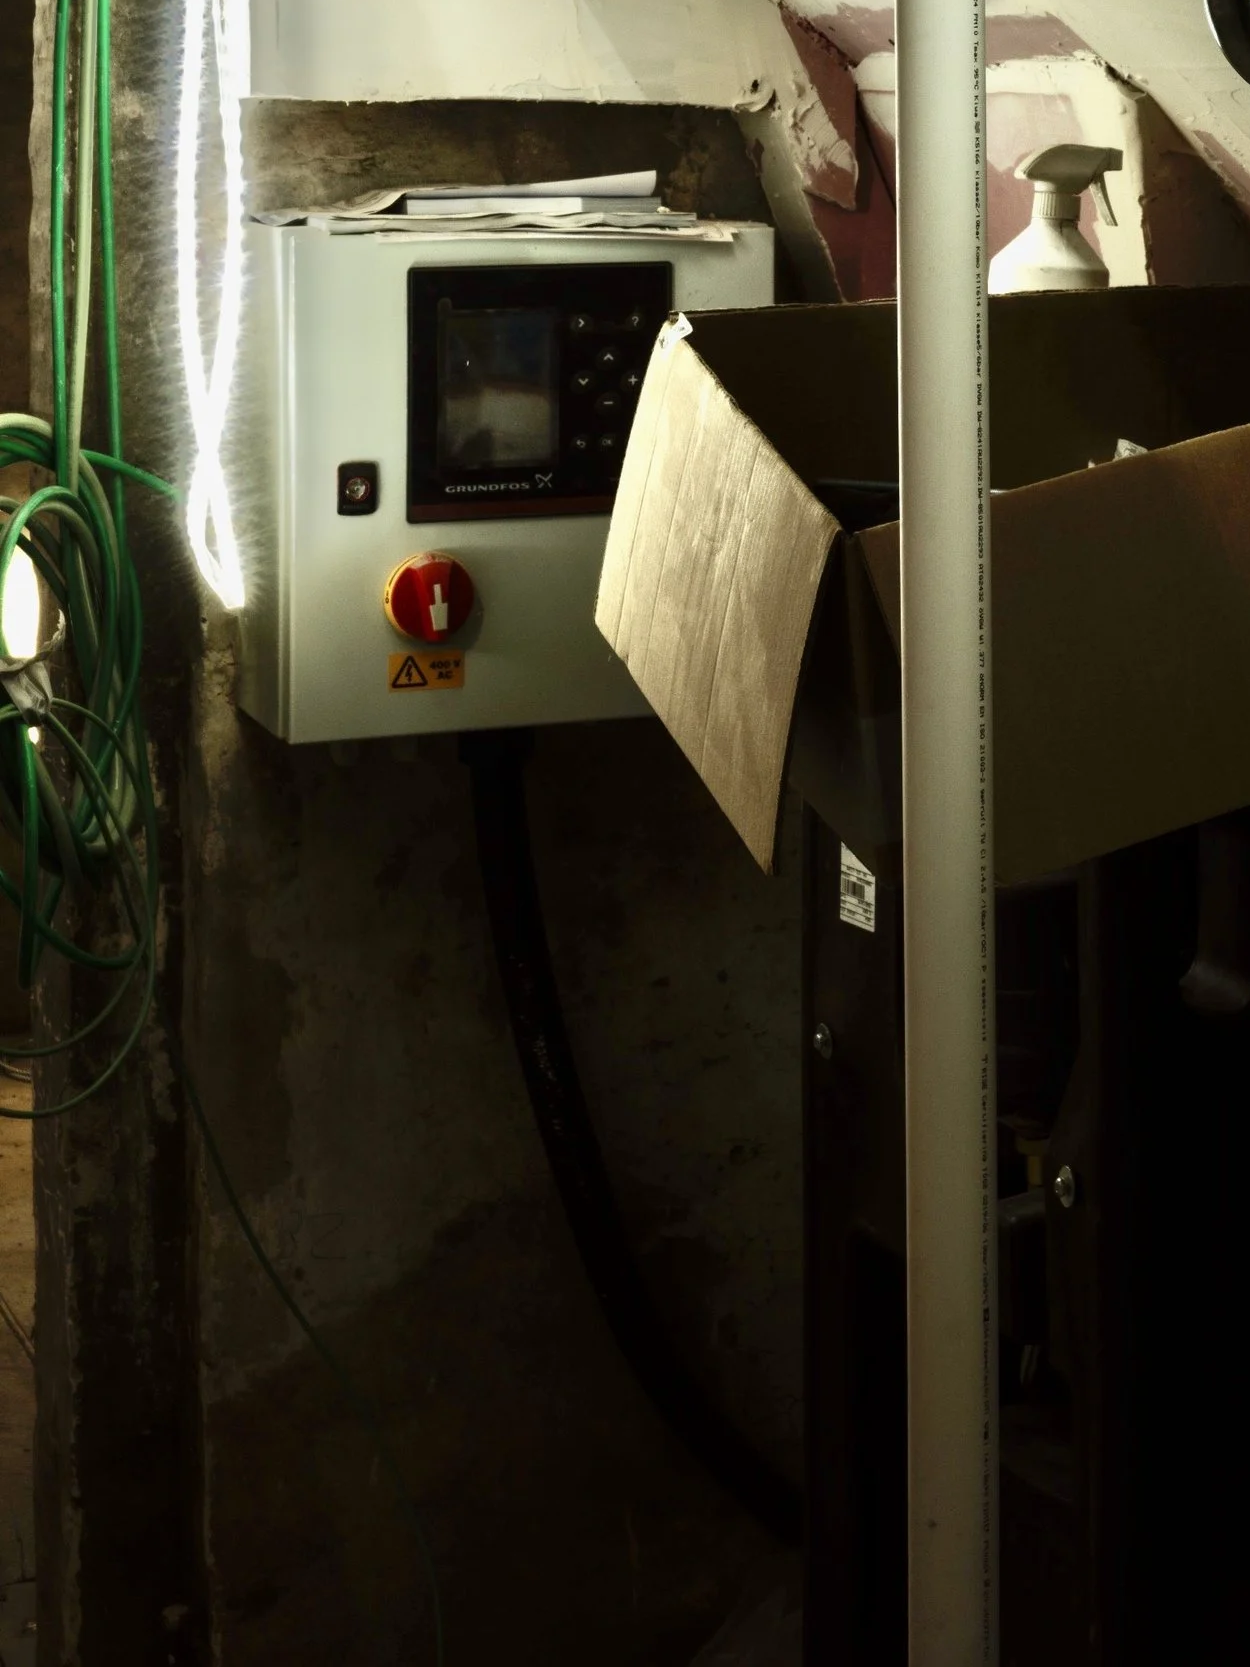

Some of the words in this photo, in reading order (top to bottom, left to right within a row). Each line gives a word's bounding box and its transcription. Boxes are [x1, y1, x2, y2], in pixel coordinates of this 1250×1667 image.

[444, 482, 530, 493] GRUNDFOS
[429, 660, 451, 670] 400
[453, 659, 462, 668] V
[437, 670, 454, 680] AC
